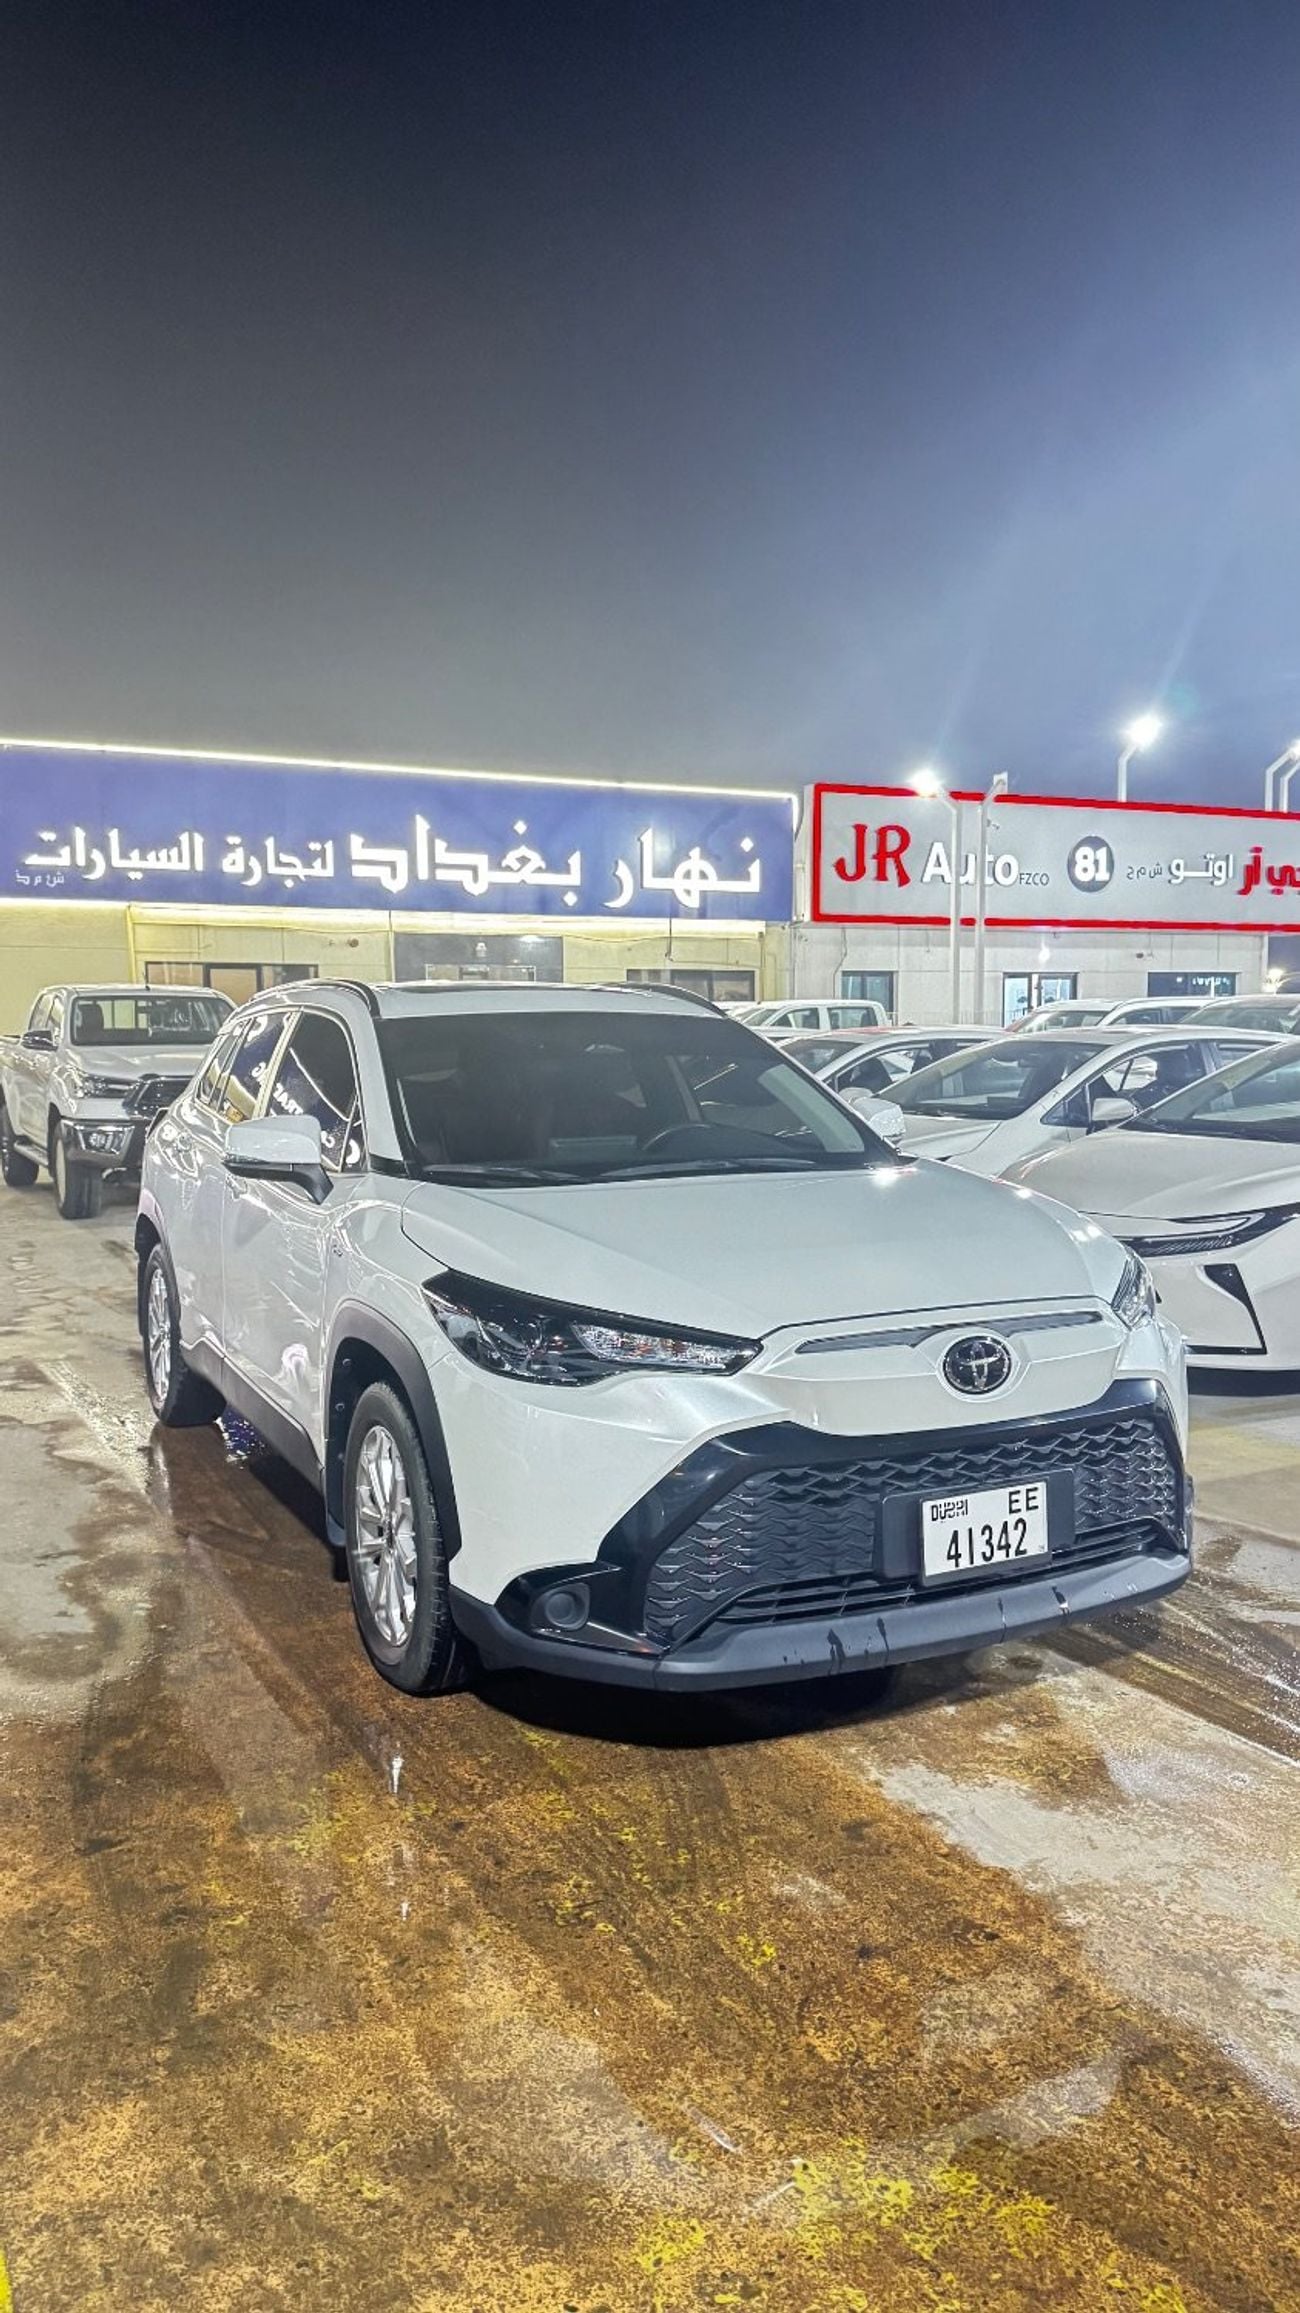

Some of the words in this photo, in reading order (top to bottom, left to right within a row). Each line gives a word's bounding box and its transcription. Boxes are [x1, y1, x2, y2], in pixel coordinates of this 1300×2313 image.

[24, 826, 204, 881] السيارات
[221, 834, 334, 888] لتجارة
[350, 814, 581, 907] بغداد
[602, 826, 760, 908] نهار
[833, 824, 912, 888] JR
[1019, 873, 1050, 886] FZCO
[1074, 846, 1111, 883] 81
[1008, 1487, 1039, 1514] EE
[946, 1517, 1028, 1568] 41342
